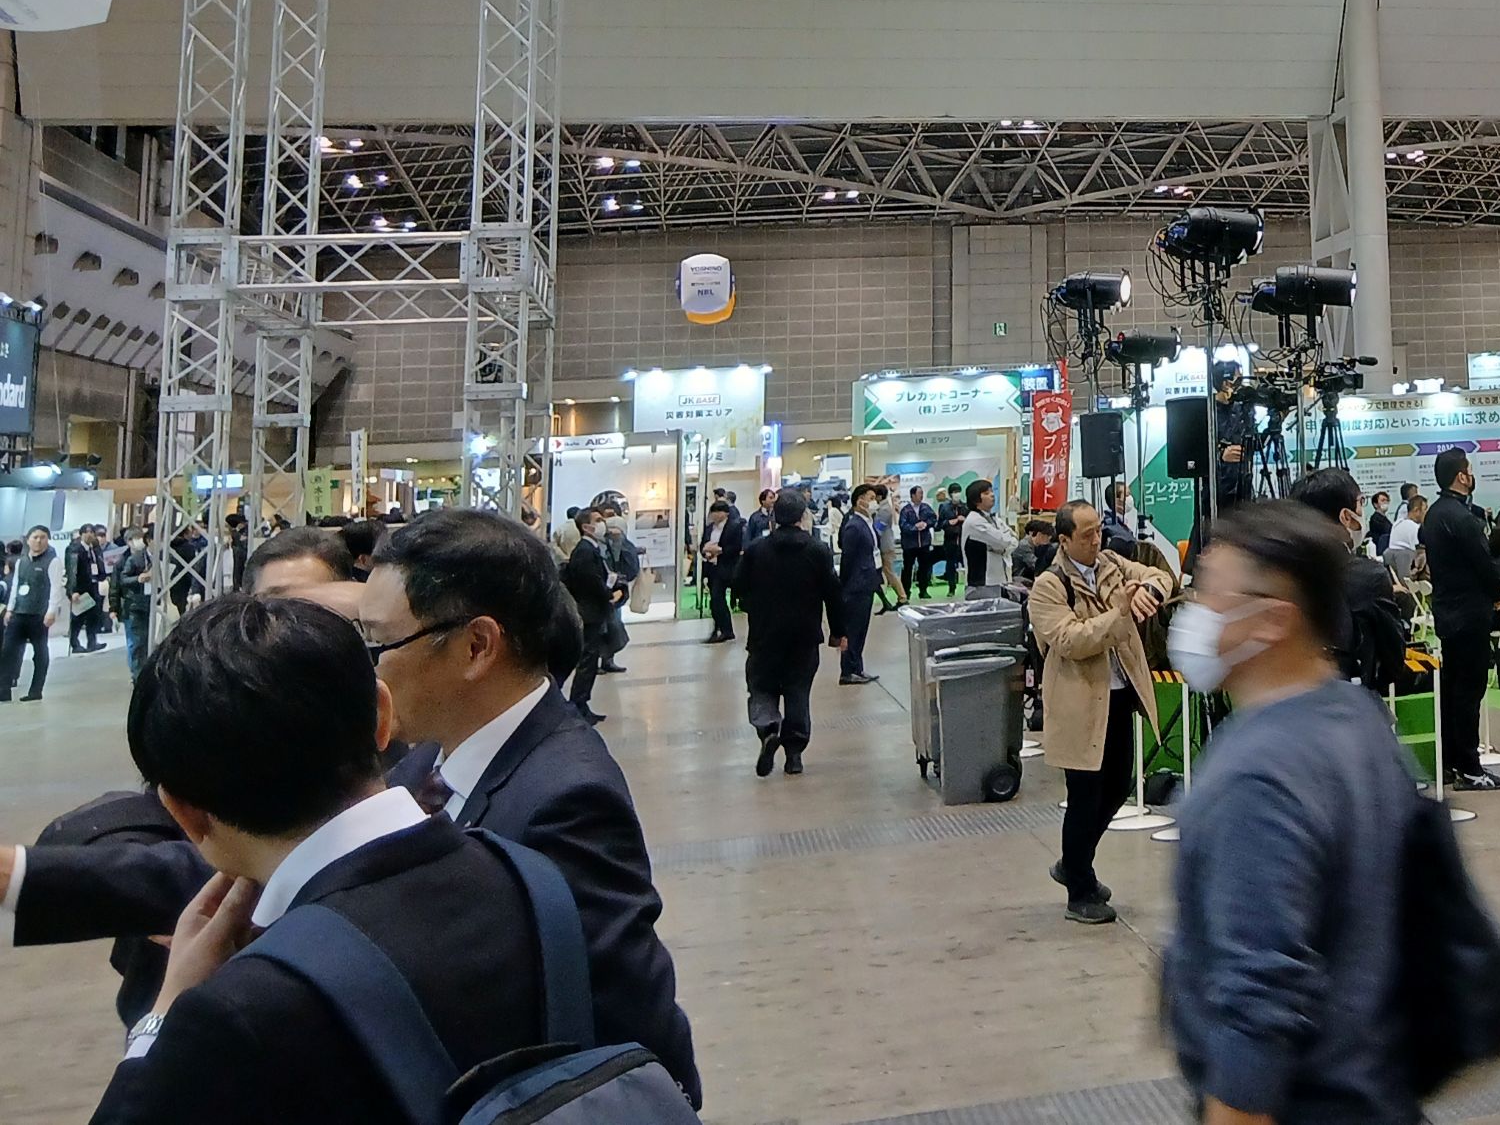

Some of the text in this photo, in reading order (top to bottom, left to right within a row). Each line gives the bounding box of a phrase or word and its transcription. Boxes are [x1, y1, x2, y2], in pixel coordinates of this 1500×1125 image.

[896, 388, 993, 402] プレカットコーナー
[1375, 448, 1393, 456] 2027
[1042, 434, 1057, 504] プレカット
[1145, 492, 1192, 505] コーナー
